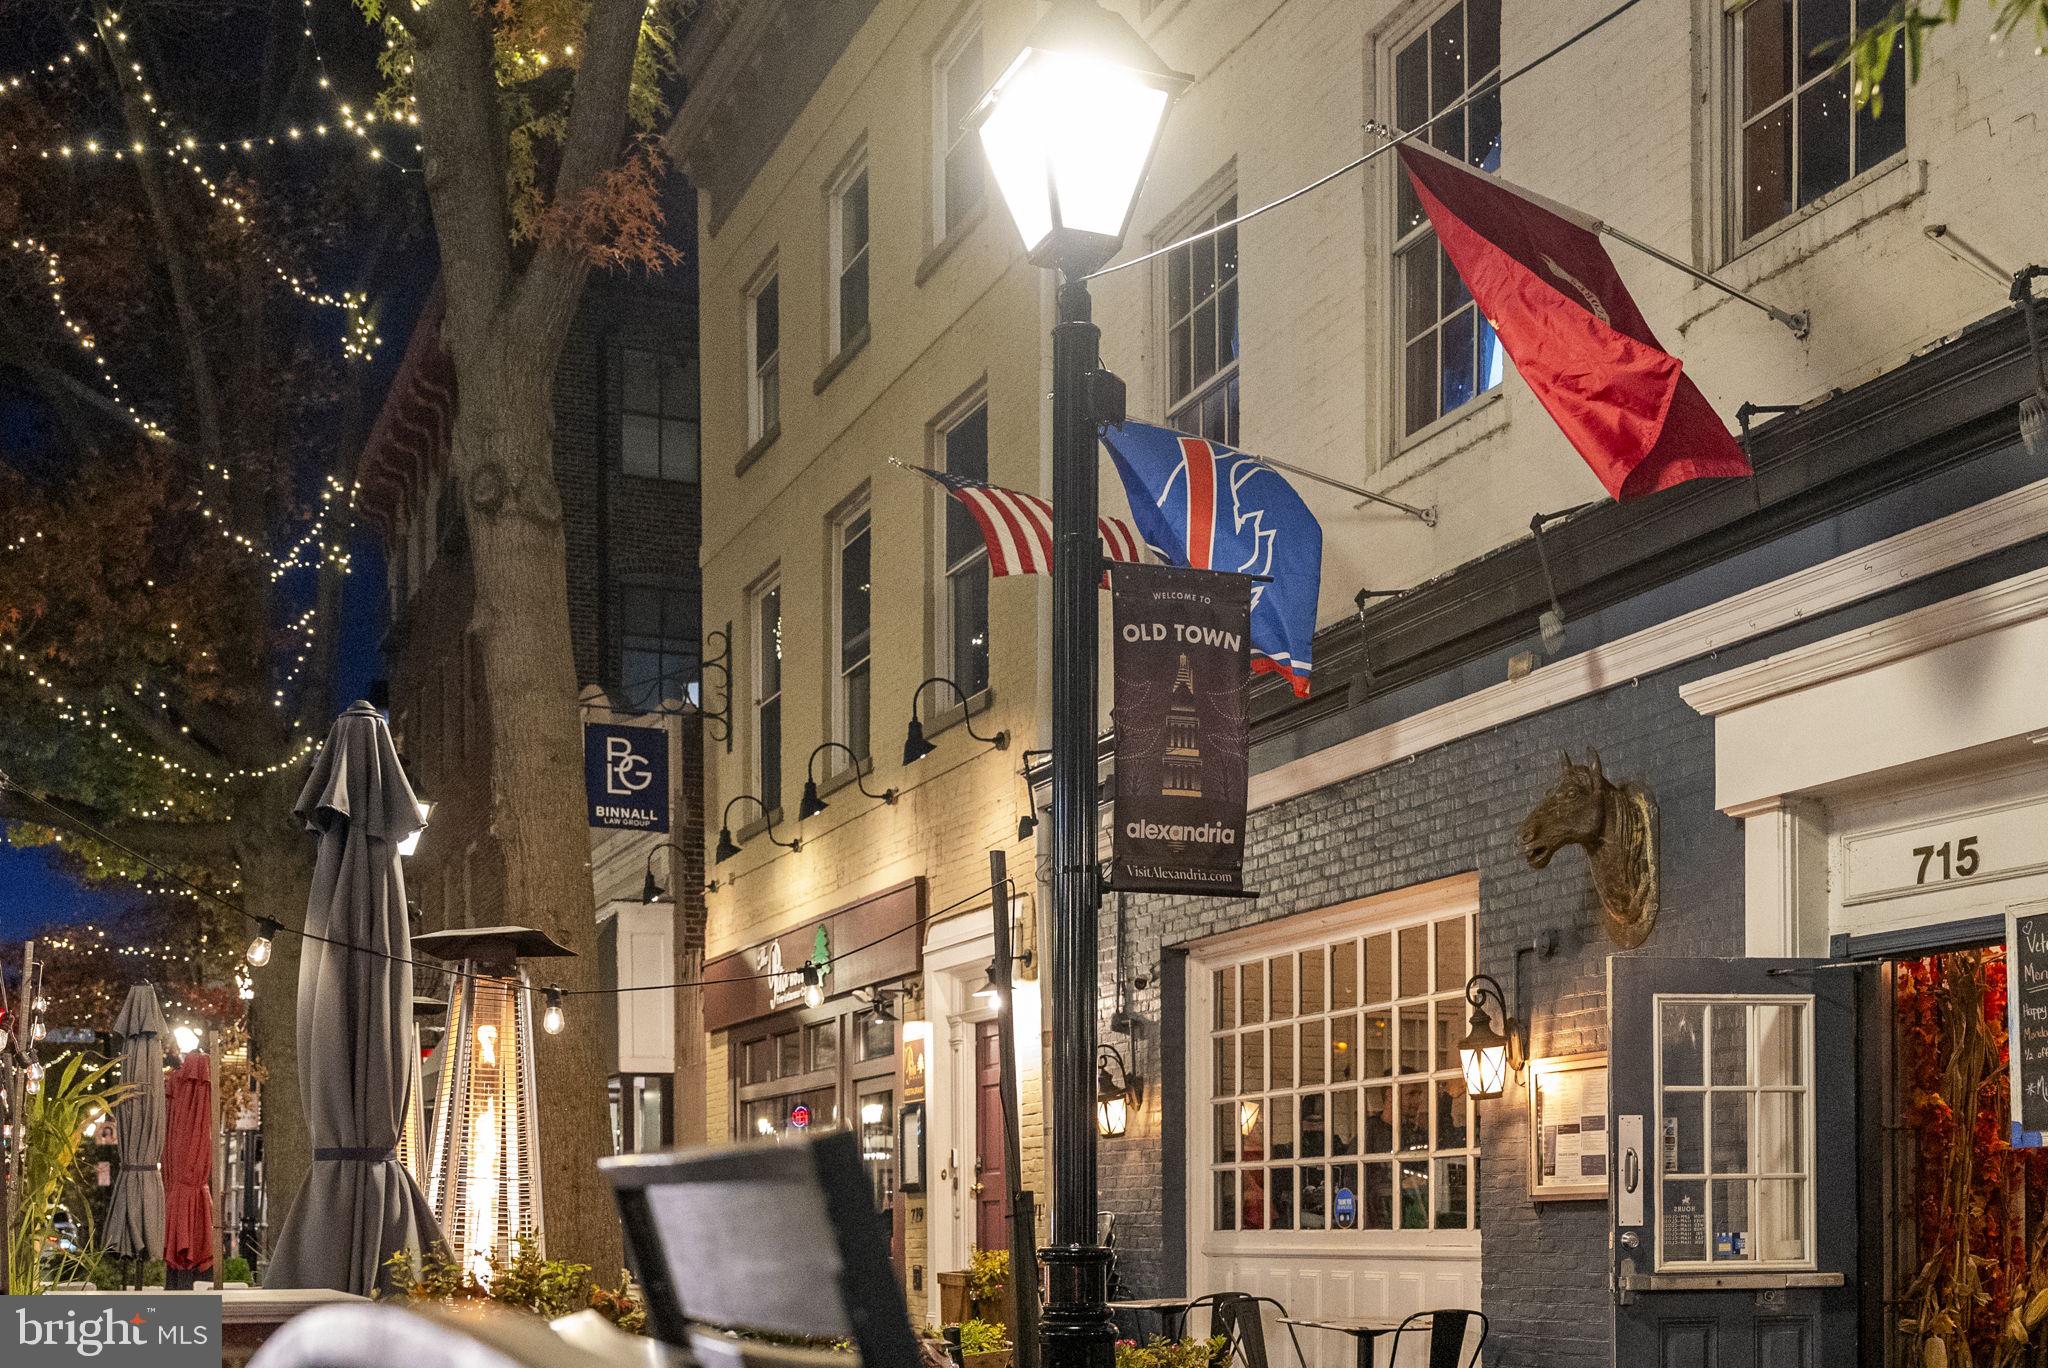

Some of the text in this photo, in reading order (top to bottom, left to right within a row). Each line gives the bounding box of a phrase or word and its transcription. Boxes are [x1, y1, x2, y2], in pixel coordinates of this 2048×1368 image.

[1152, 591, 1212, 605] WELCOME TO
[1122, 623, 1242, 653] OLD TOWN
[595, 805, 659, 821] BINNALL
[603, 817, 651, 827] LAW GROUP
[1126, 818, 1236, 845] alexandria
[1912, 835, 1981, 885] 715
[1126, 864, 1232, 883] VisitAlexandria.com
[2022, 1003, 2048, 1021] Happy
[910, 1207, 924, 1223] 719
